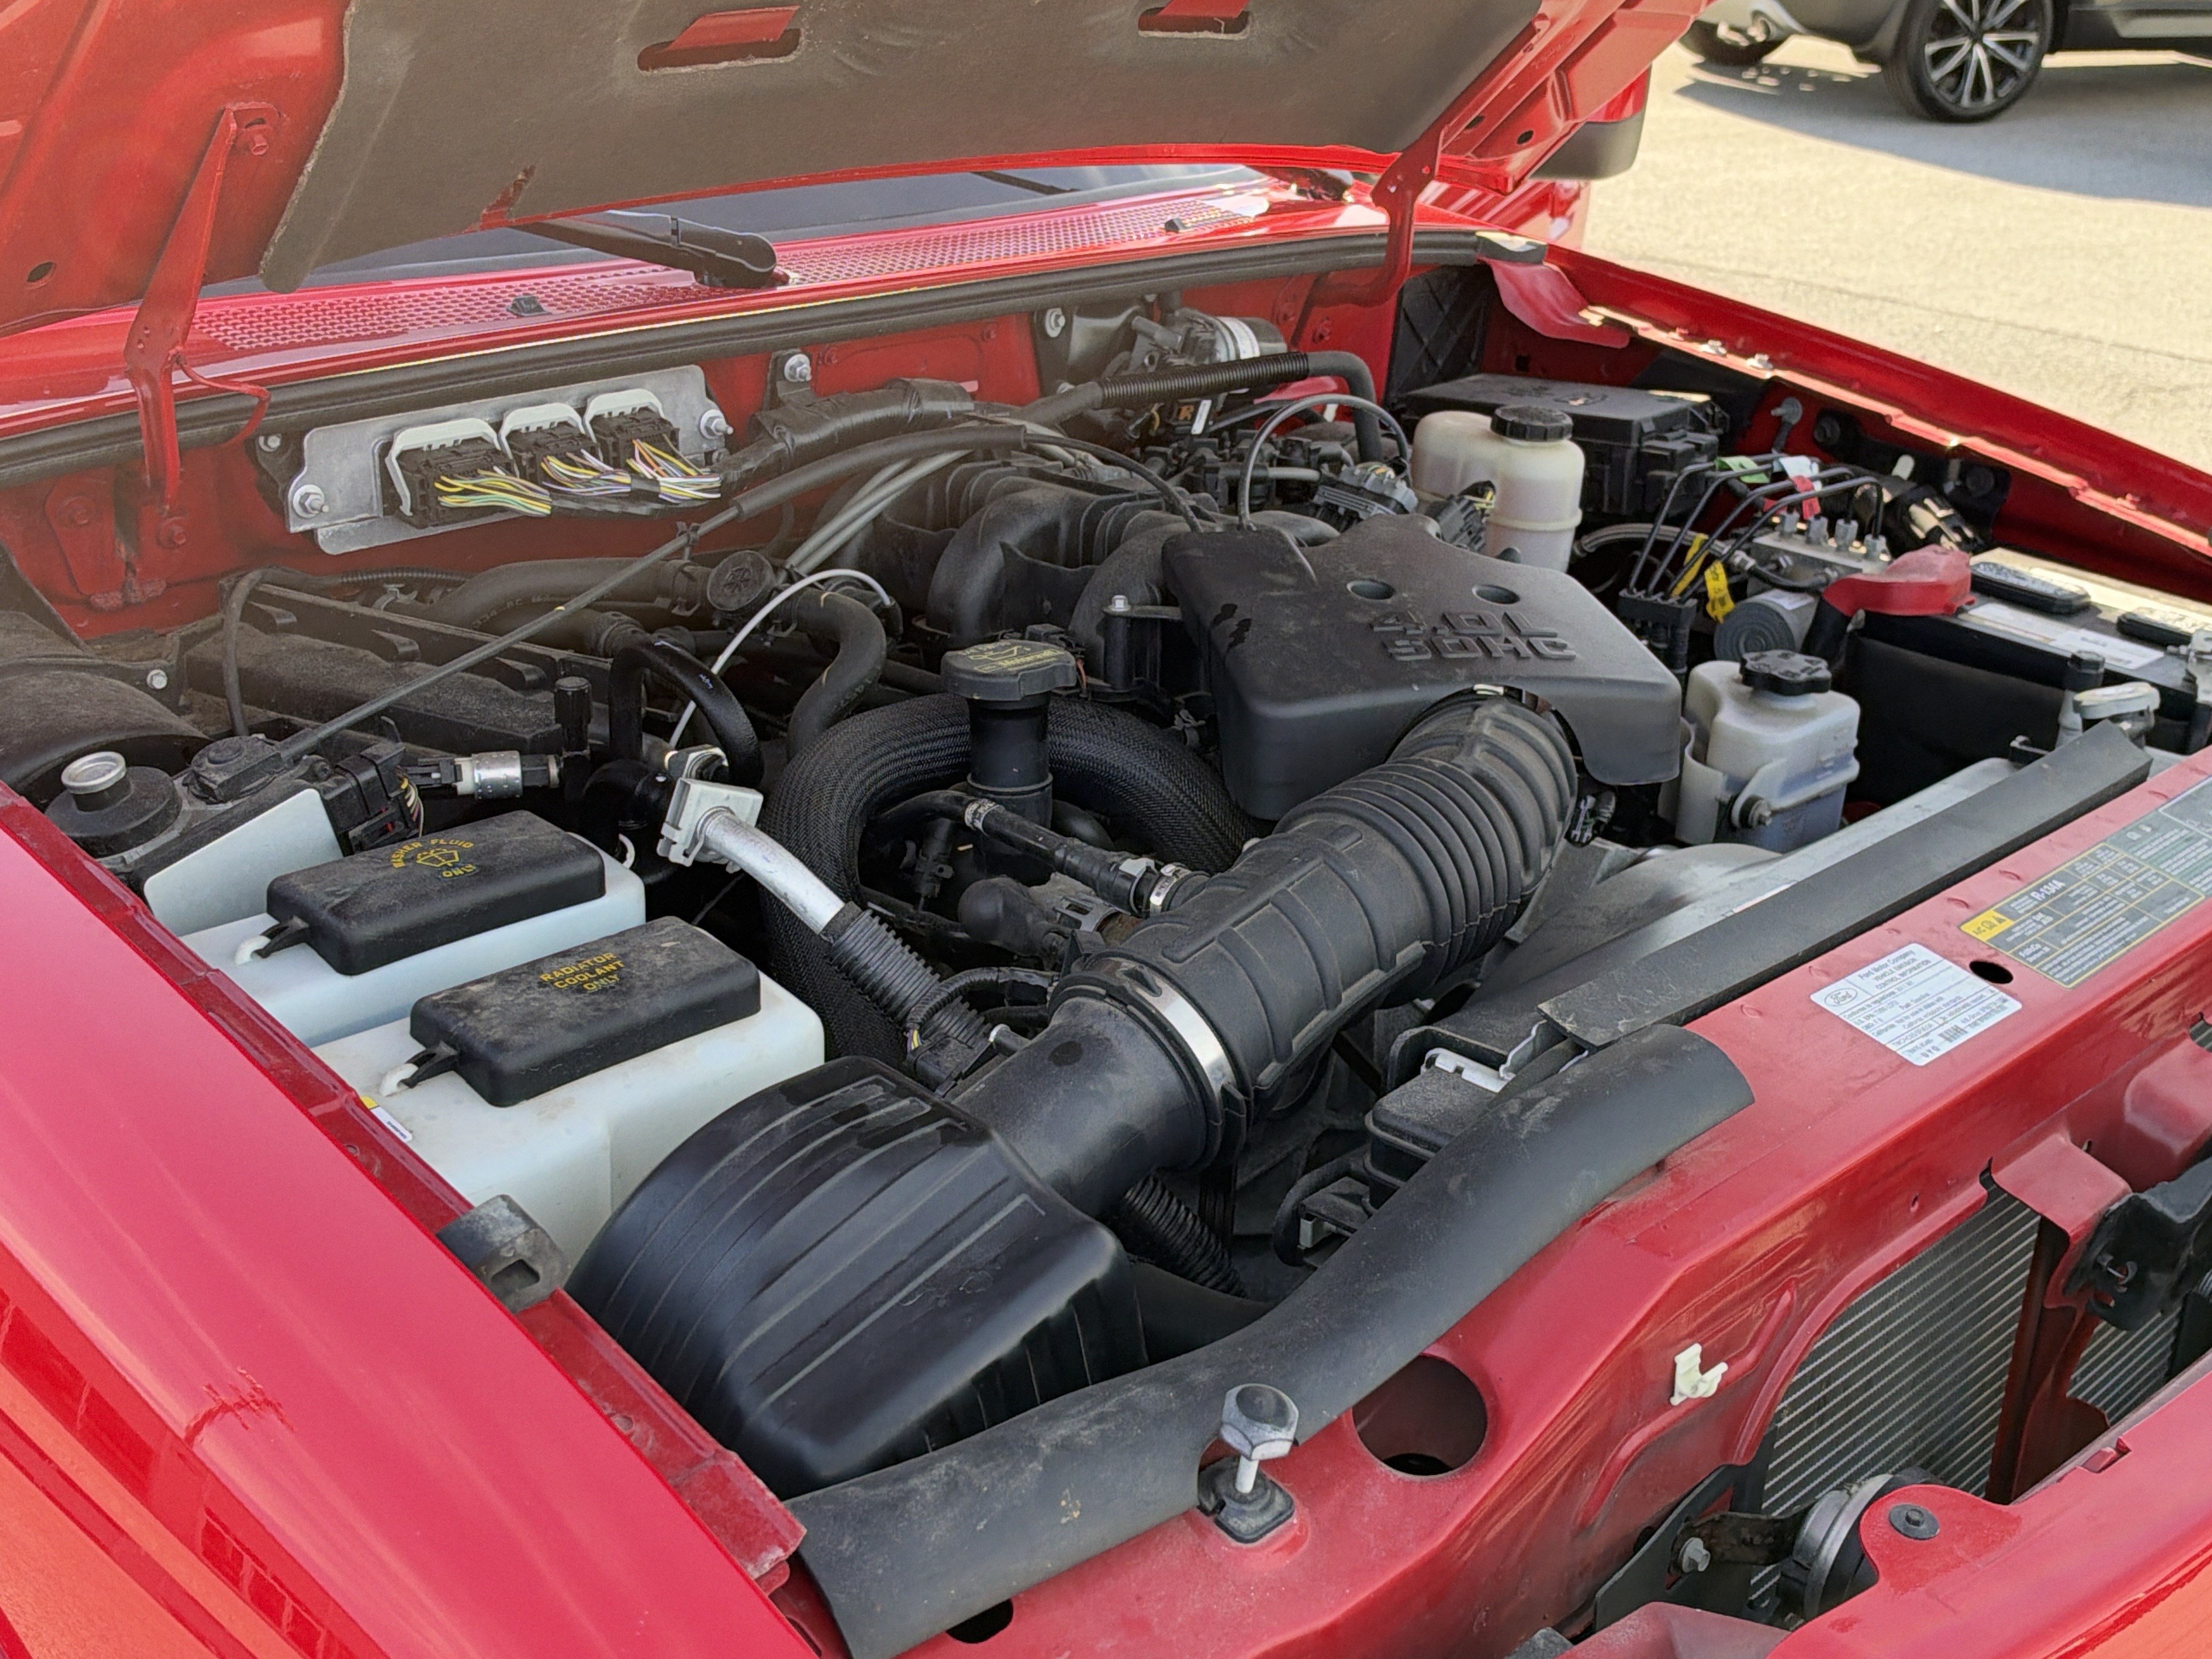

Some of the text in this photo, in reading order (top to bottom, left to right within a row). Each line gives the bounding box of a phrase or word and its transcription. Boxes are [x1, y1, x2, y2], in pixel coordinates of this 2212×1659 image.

[1370, 610, 1558, 637] 4.0L
[1382, 635, 1576, 661] SOHC
[430, 838, 474, 849] FLUID
[540, 952, 617, 981] RADIATOR
[554, 960, 625, 989] COOLANT
[583, 974, 620, 991] ONLY
